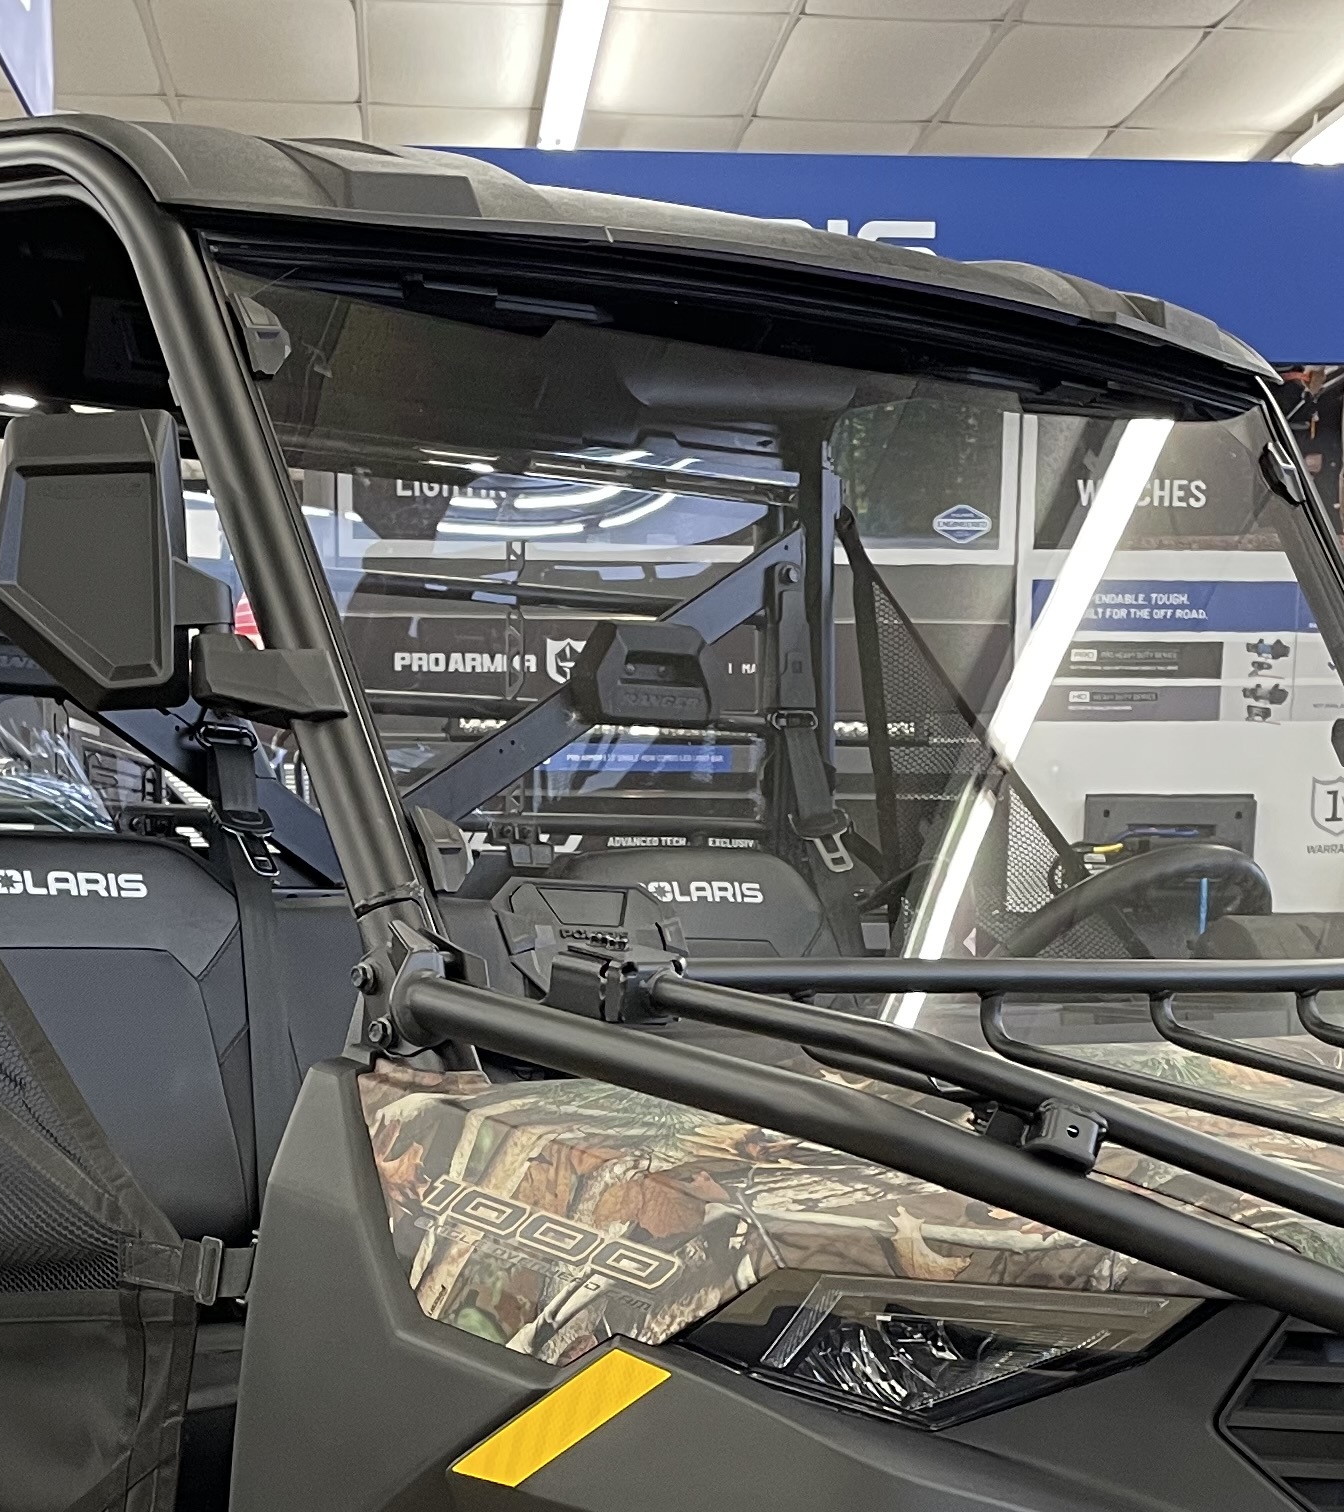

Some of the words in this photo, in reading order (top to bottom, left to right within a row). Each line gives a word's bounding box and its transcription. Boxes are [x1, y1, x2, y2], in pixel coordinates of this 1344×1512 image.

[1077, 479, 1207, 508] WCHES
[1095, 593, 1148, 605] ENDABLE.
[1106, 608, 1128, 620] FOR
[1129, 608, 1151, 620] THE
[1152, 609, 1174, 620] OFF
[1325, 789, 1344, 822] 1
[708, 837, 755, 849] EXCLUSIV
[640, 881, 764, 904] OLARIS
[421, 1174, 682, 1290] 1000
